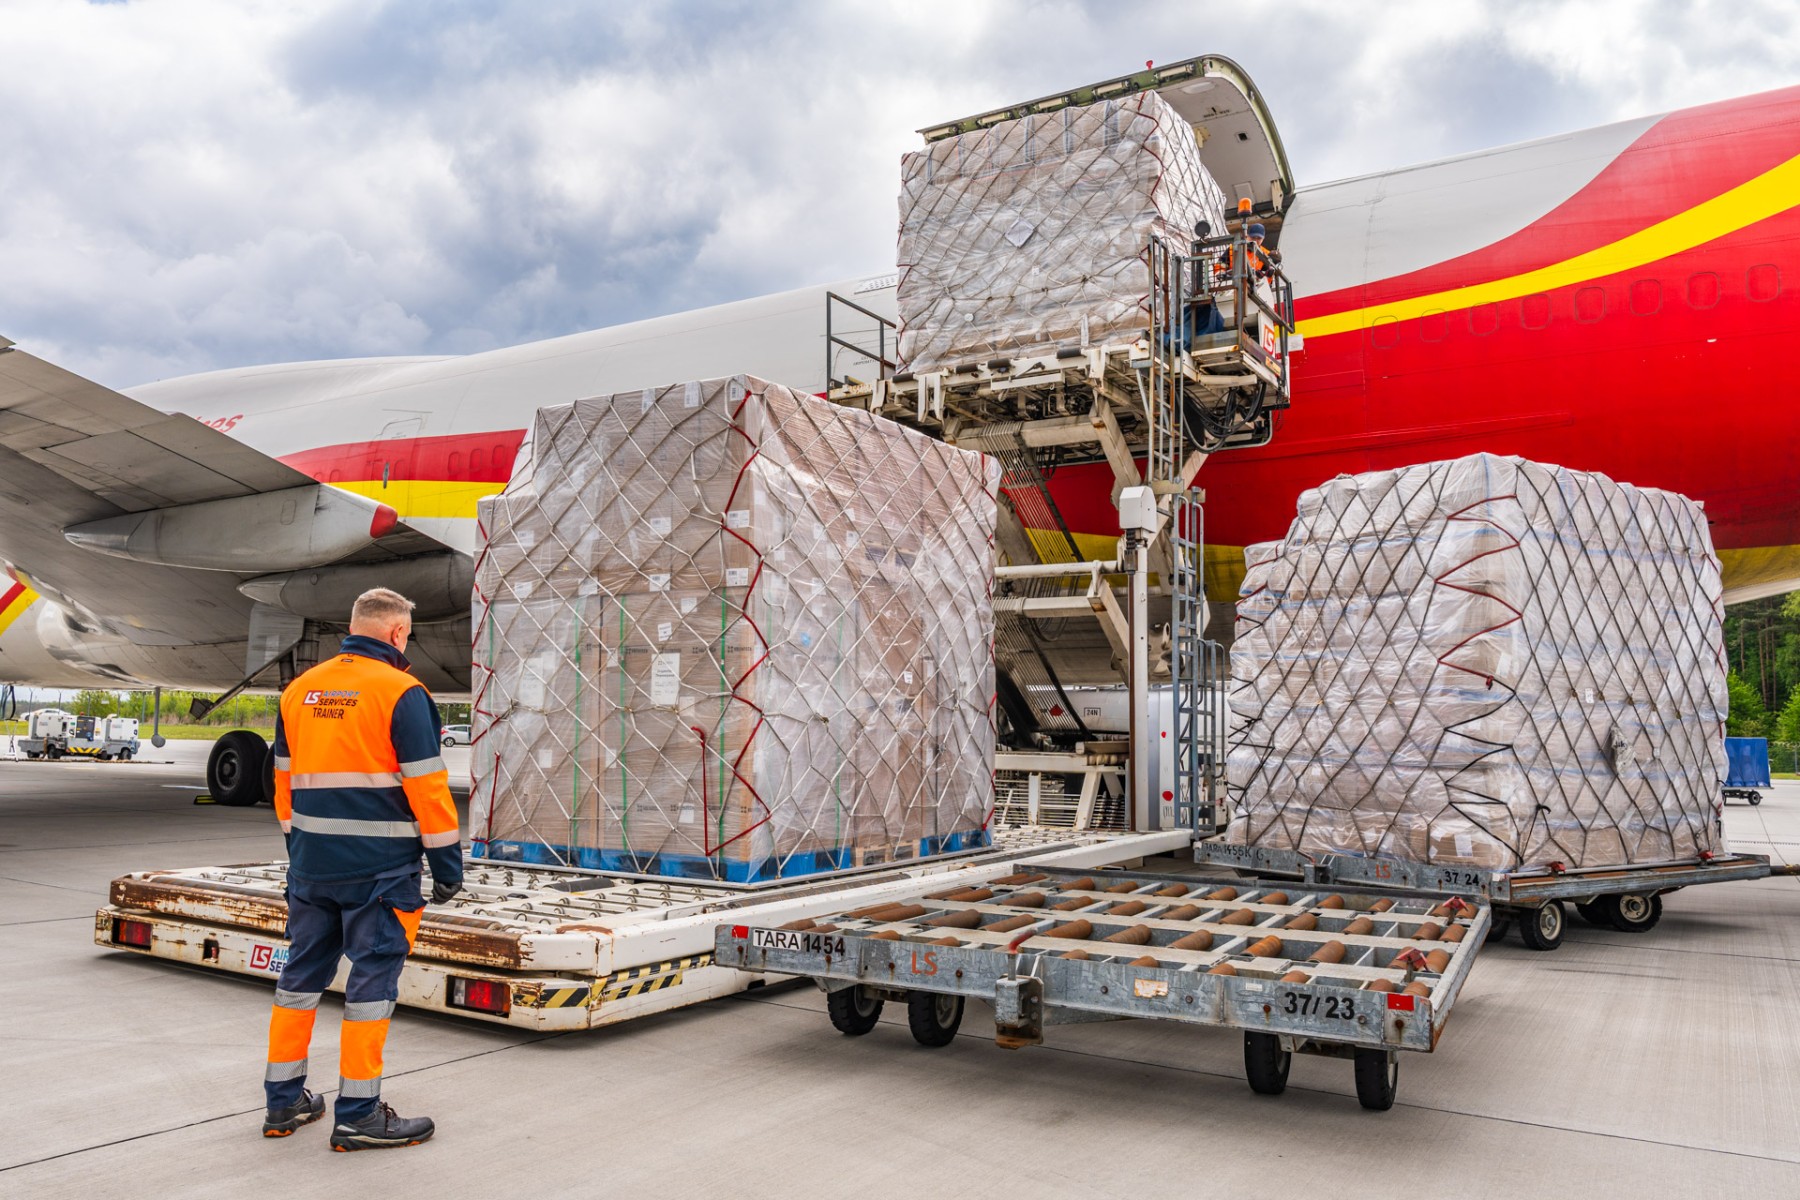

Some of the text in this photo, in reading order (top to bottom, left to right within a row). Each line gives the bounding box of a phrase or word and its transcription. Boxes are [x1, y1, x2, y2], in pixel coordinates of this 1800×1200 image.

[303, 691, 321, 704] LS
[324, 690, 360, 698] AIRPORT
[319, 698, 358, 707] SERVICES
[313, 707, 345, 719] TRAINER
[1375, 864, 1391, 879] LS
[1444, 871, 1479, 886] 37 24
[755, 930, 845, 956] TARA 1454
[251, 946, 272, 968] LS
[911, 951, 938, 976] LS
[269, 960, 286, 973] SE
[1284, 992, 1355, 1020] 37/23
